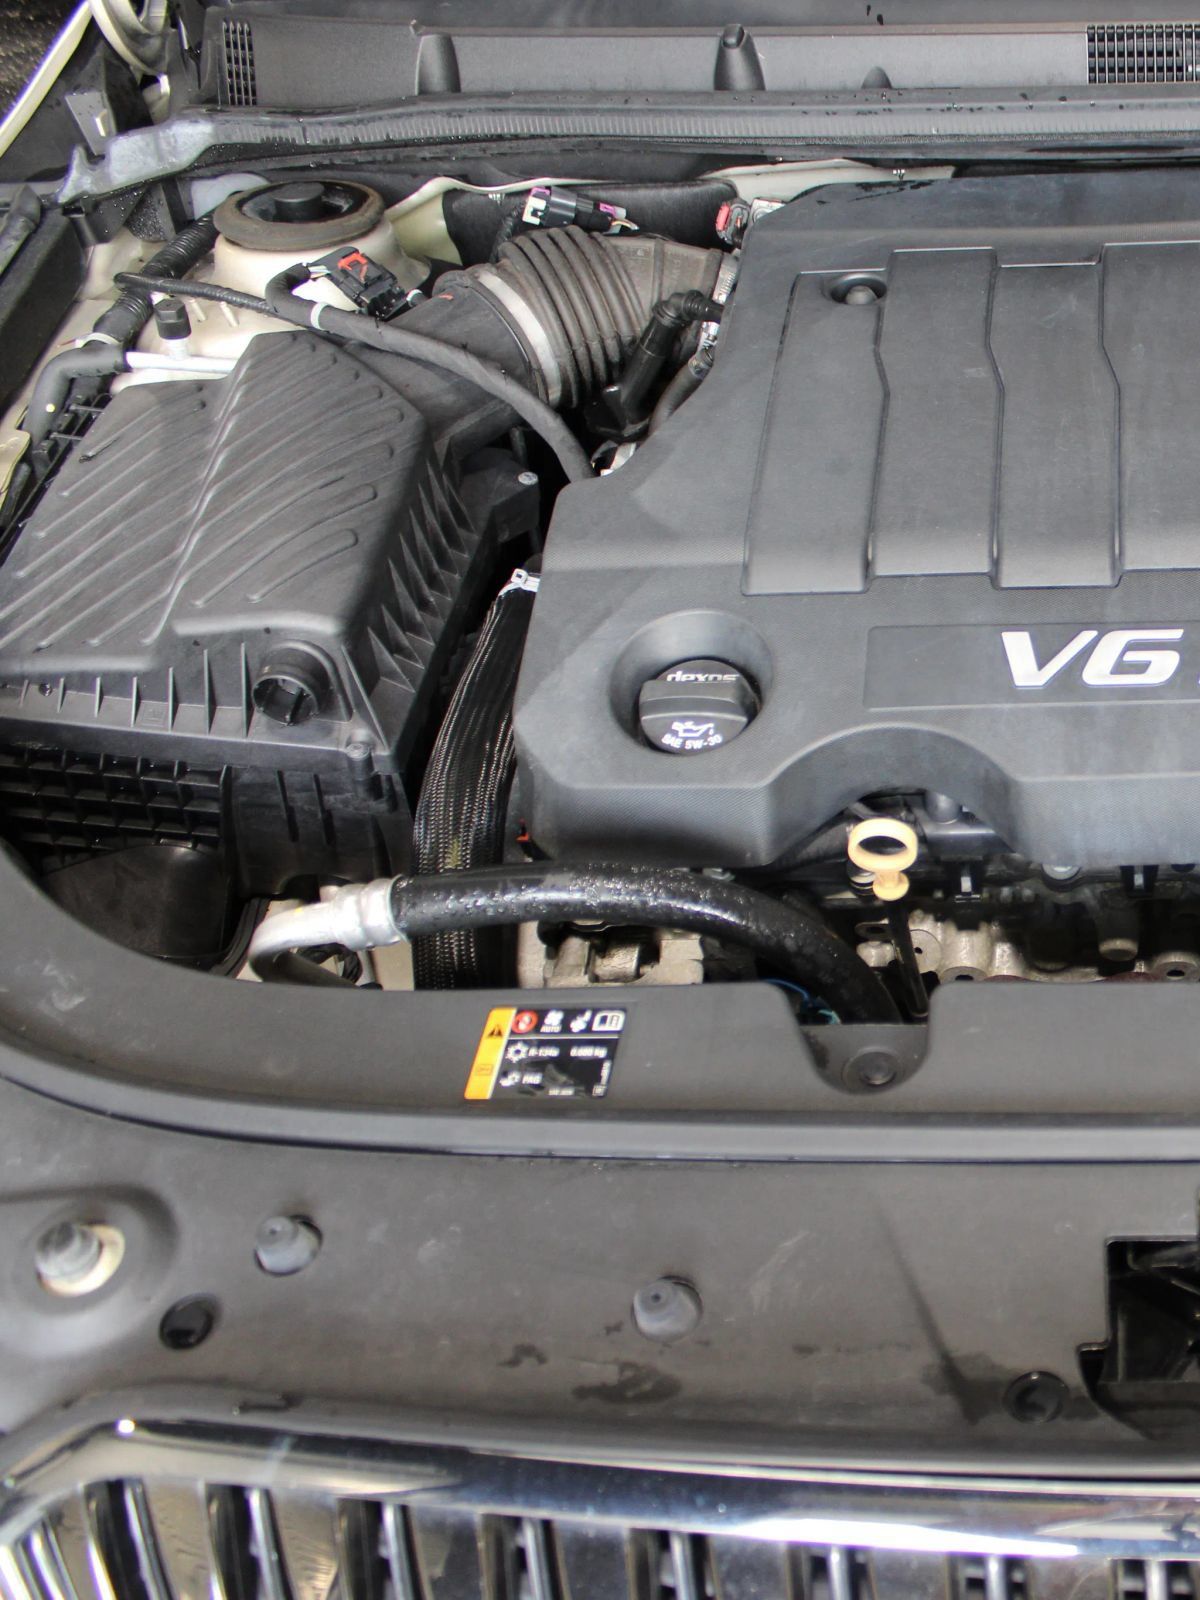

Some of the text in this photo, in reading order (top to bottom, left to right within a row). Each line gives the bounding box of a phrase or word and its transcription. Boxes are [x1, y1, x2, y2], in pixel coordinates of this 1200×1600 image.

[1001, 628, 1185, 689] V6
[661, 733, 723, 750] SAE 5W-30
[540, 1023, 562, 1033] AUTO
